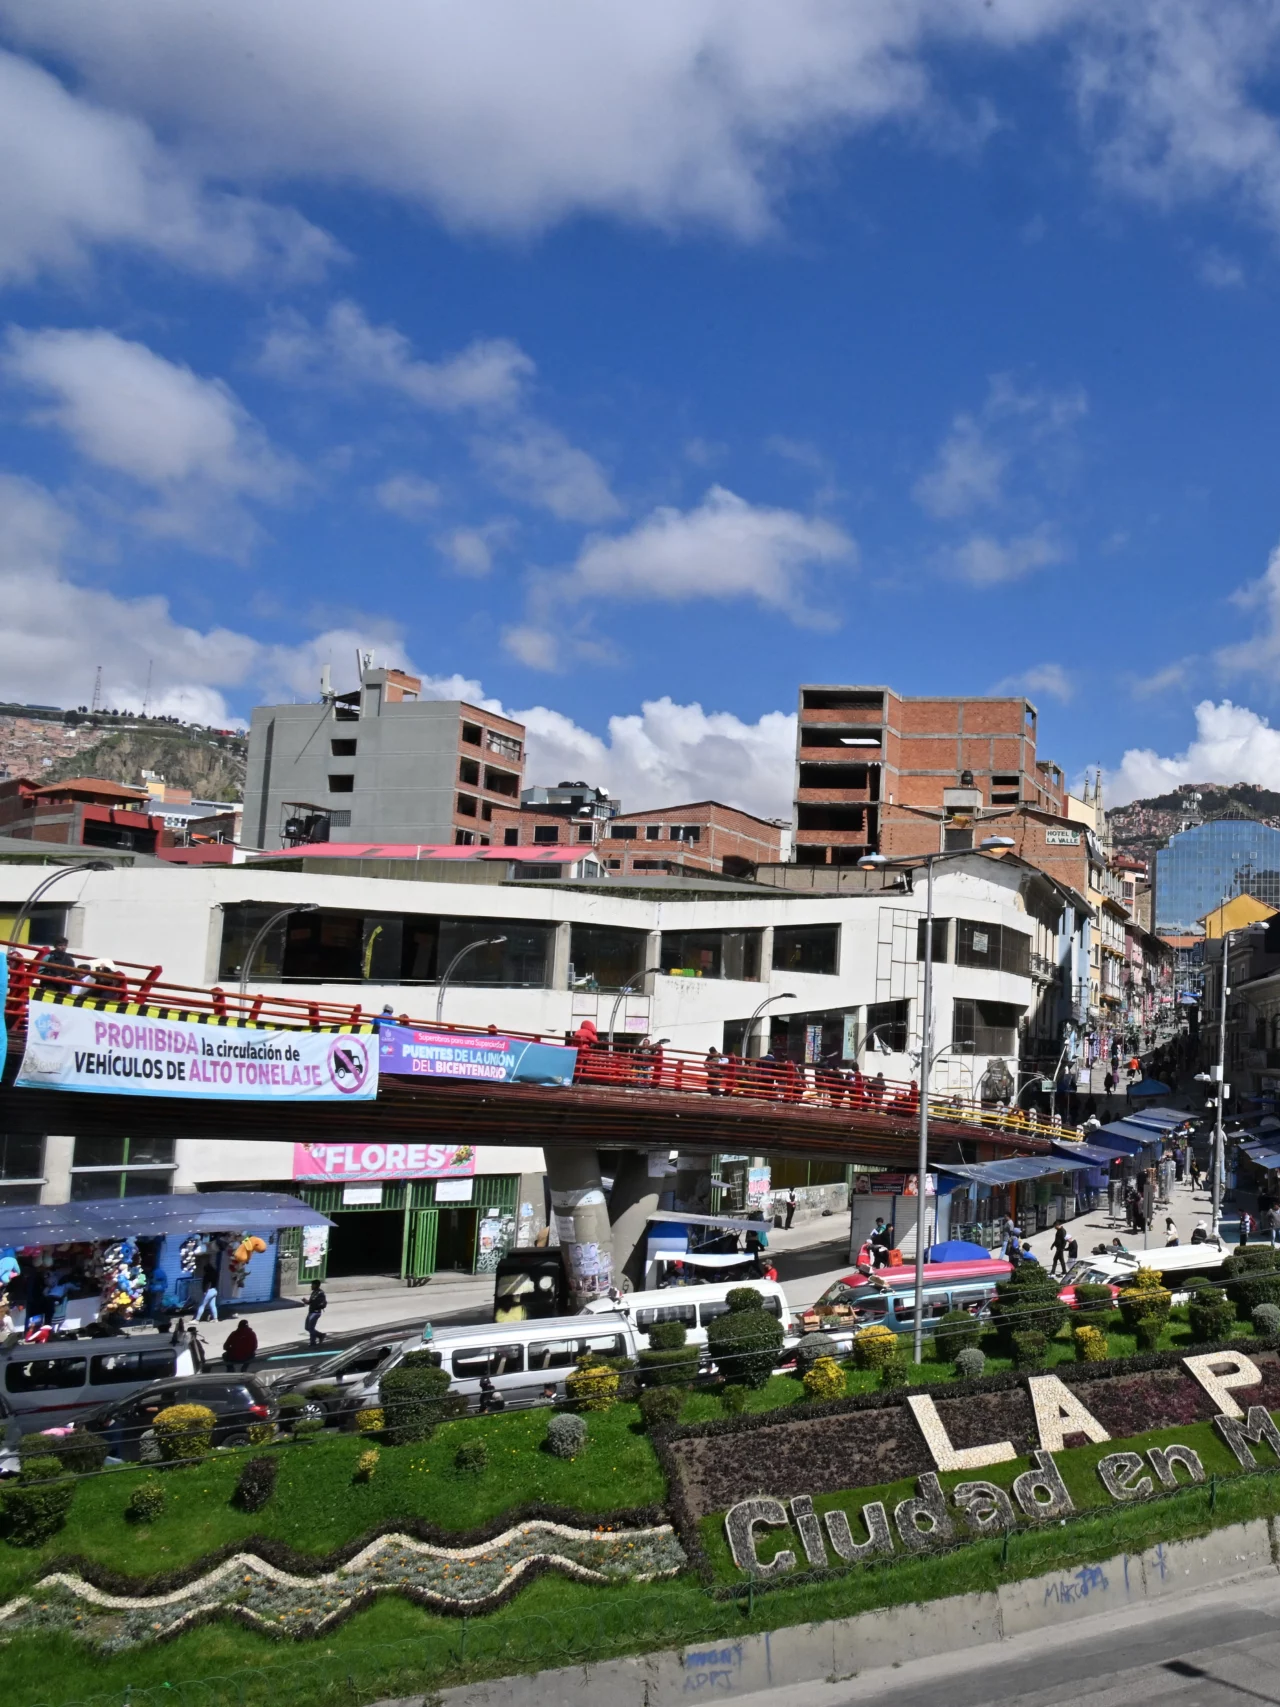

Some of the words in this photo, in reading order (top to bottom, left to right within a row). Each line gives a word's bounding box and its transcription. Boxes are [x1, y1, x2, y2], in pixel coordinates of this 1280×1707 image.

[94, 1020, 199, 1055] PROHIBIDA
[201, 1037, 214, 1057] la
[216, 1039, 282, 1062] circulación
[284, 1044, 300, 1062] de
[402, 1044, 454, 1061] PUENTES
[454, 1048, 469, 1062] DE
[469, 1050, 483, 1063] LA
[483, 1050, 515, 1067] UNIÓN
[74, 1050, 164, 1080] VEHÍCULOS
[166, 1060, 186, 1081] DE
[189, 1060, 233, 1084] ALTO
[235, 1062, 323, 1087] TONELAJE
[412, 1058, 434, 1073] DEL
[435, 1062, 507, 1079] BICENTENARIO
[907, 1375, 1112, 1472] LA
[724, 1449, 1076, 1580] Ciudad
[1097, 1443, 1206, 1500] en
